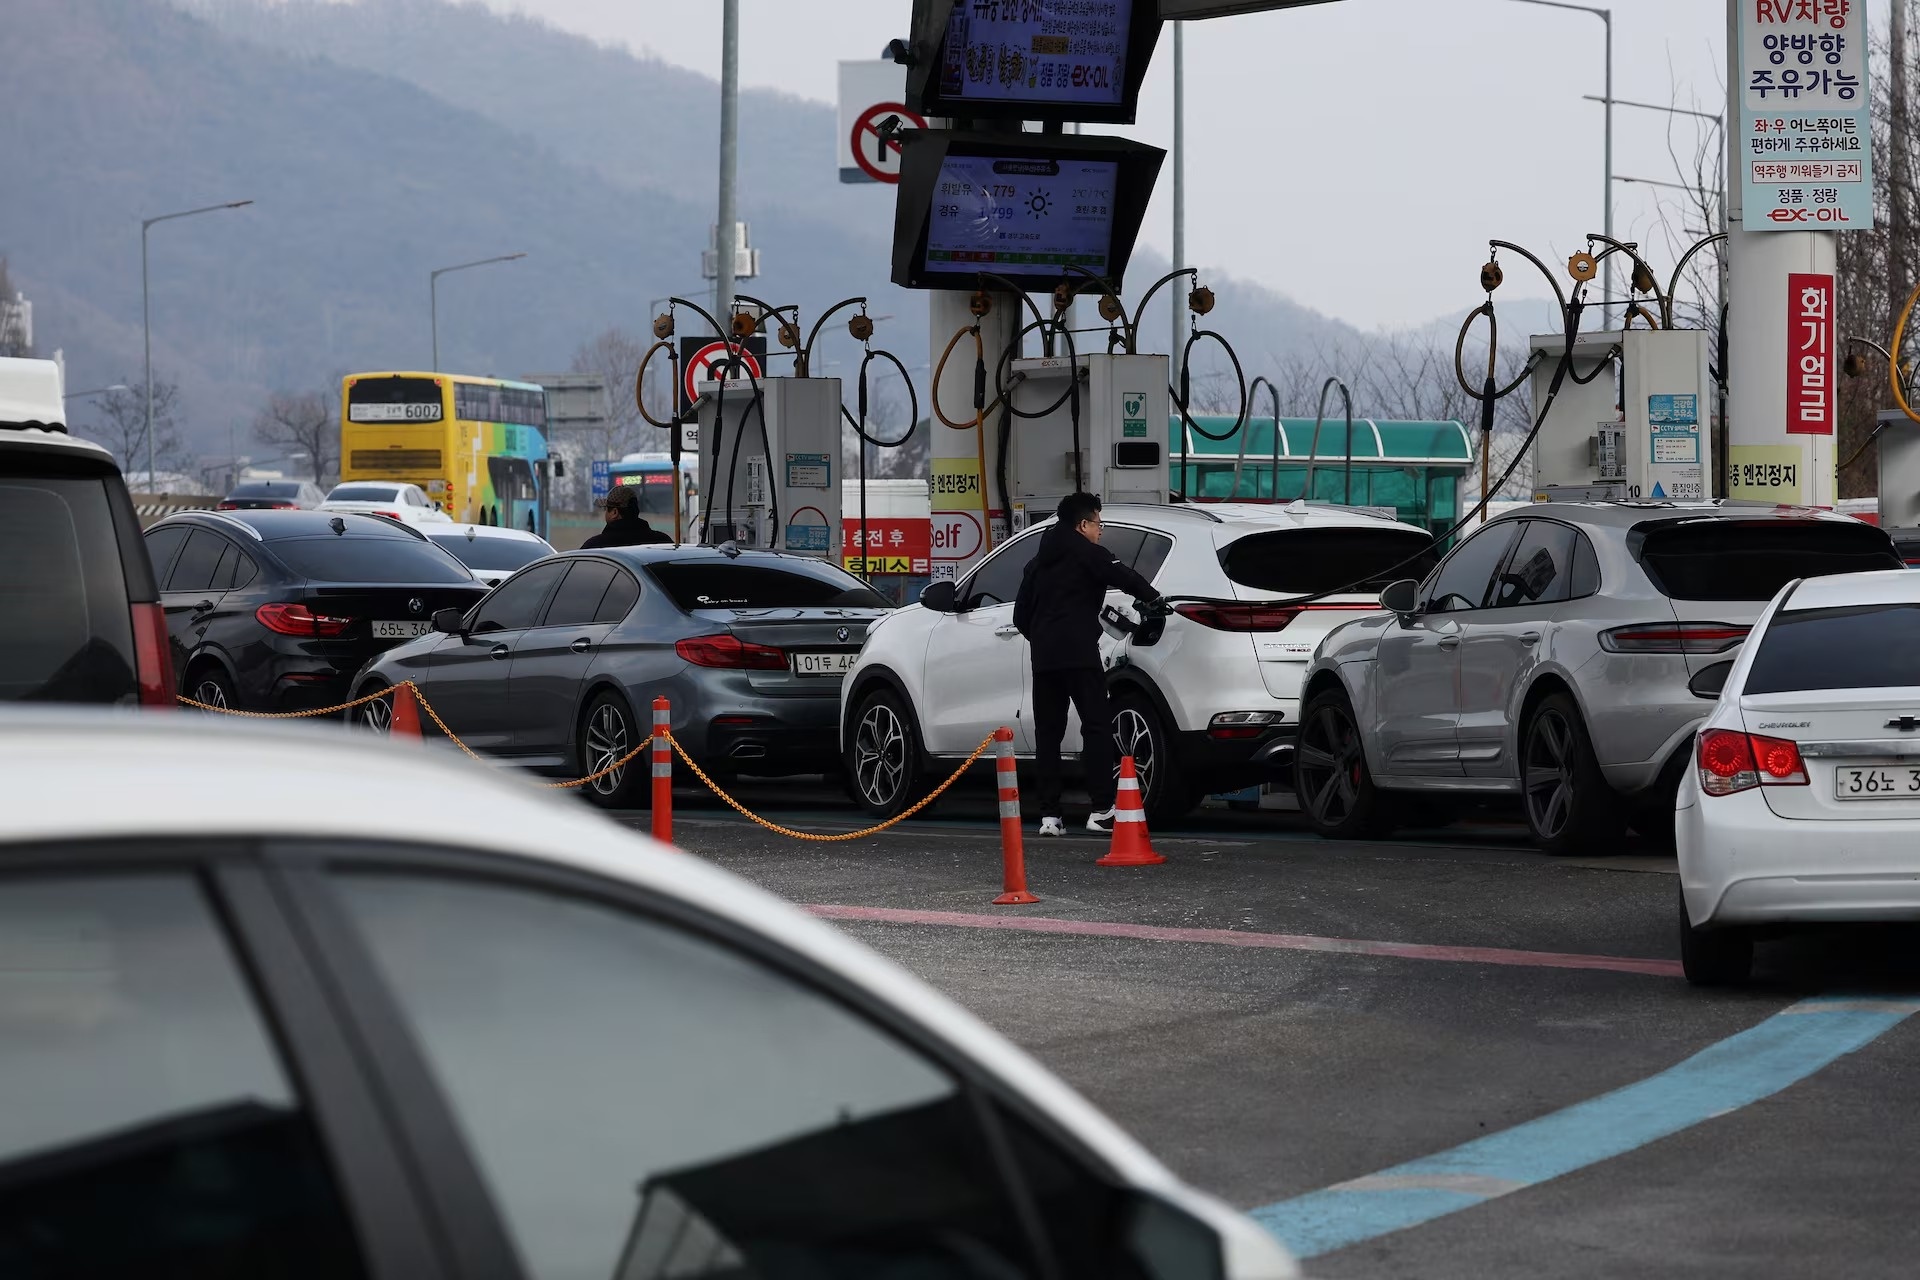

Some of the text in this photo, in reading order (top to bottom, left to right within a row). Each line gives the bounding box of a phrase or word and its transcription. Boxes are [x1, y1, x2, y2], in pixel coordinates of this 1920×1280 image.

[1756, 0, 1850, 29] RV차량
[1763, 33, 1846, 65] 양방향
[1749, 69, 1860, 100] 주유가능
[1790, 118, 1857, 134] 어느쪽이든
[1751, 137, 1861, 153] 편하게 주유하세요
[1754, 164, 1787, 178] 역주행
[1836, 164, 1858, 178] 금지
[940, 182, 972, 196] 휘발유
[939, 205, 959, 217] 경유
[1800, 287, 1828, 423] 화기엄금
[405, 405, 439, 418] 6002
[1743, 464, 1796, 487] 엔진정지
[937, 473, 980, 495] 엔진정지
[1628, 485, 1641, 498] 10
[889, 529, 905, 548] 후
[379, 622, 405, 636] 65노
[804, 655, 832, 671] 01두
[1849, 769, 1895, 793] 36노
